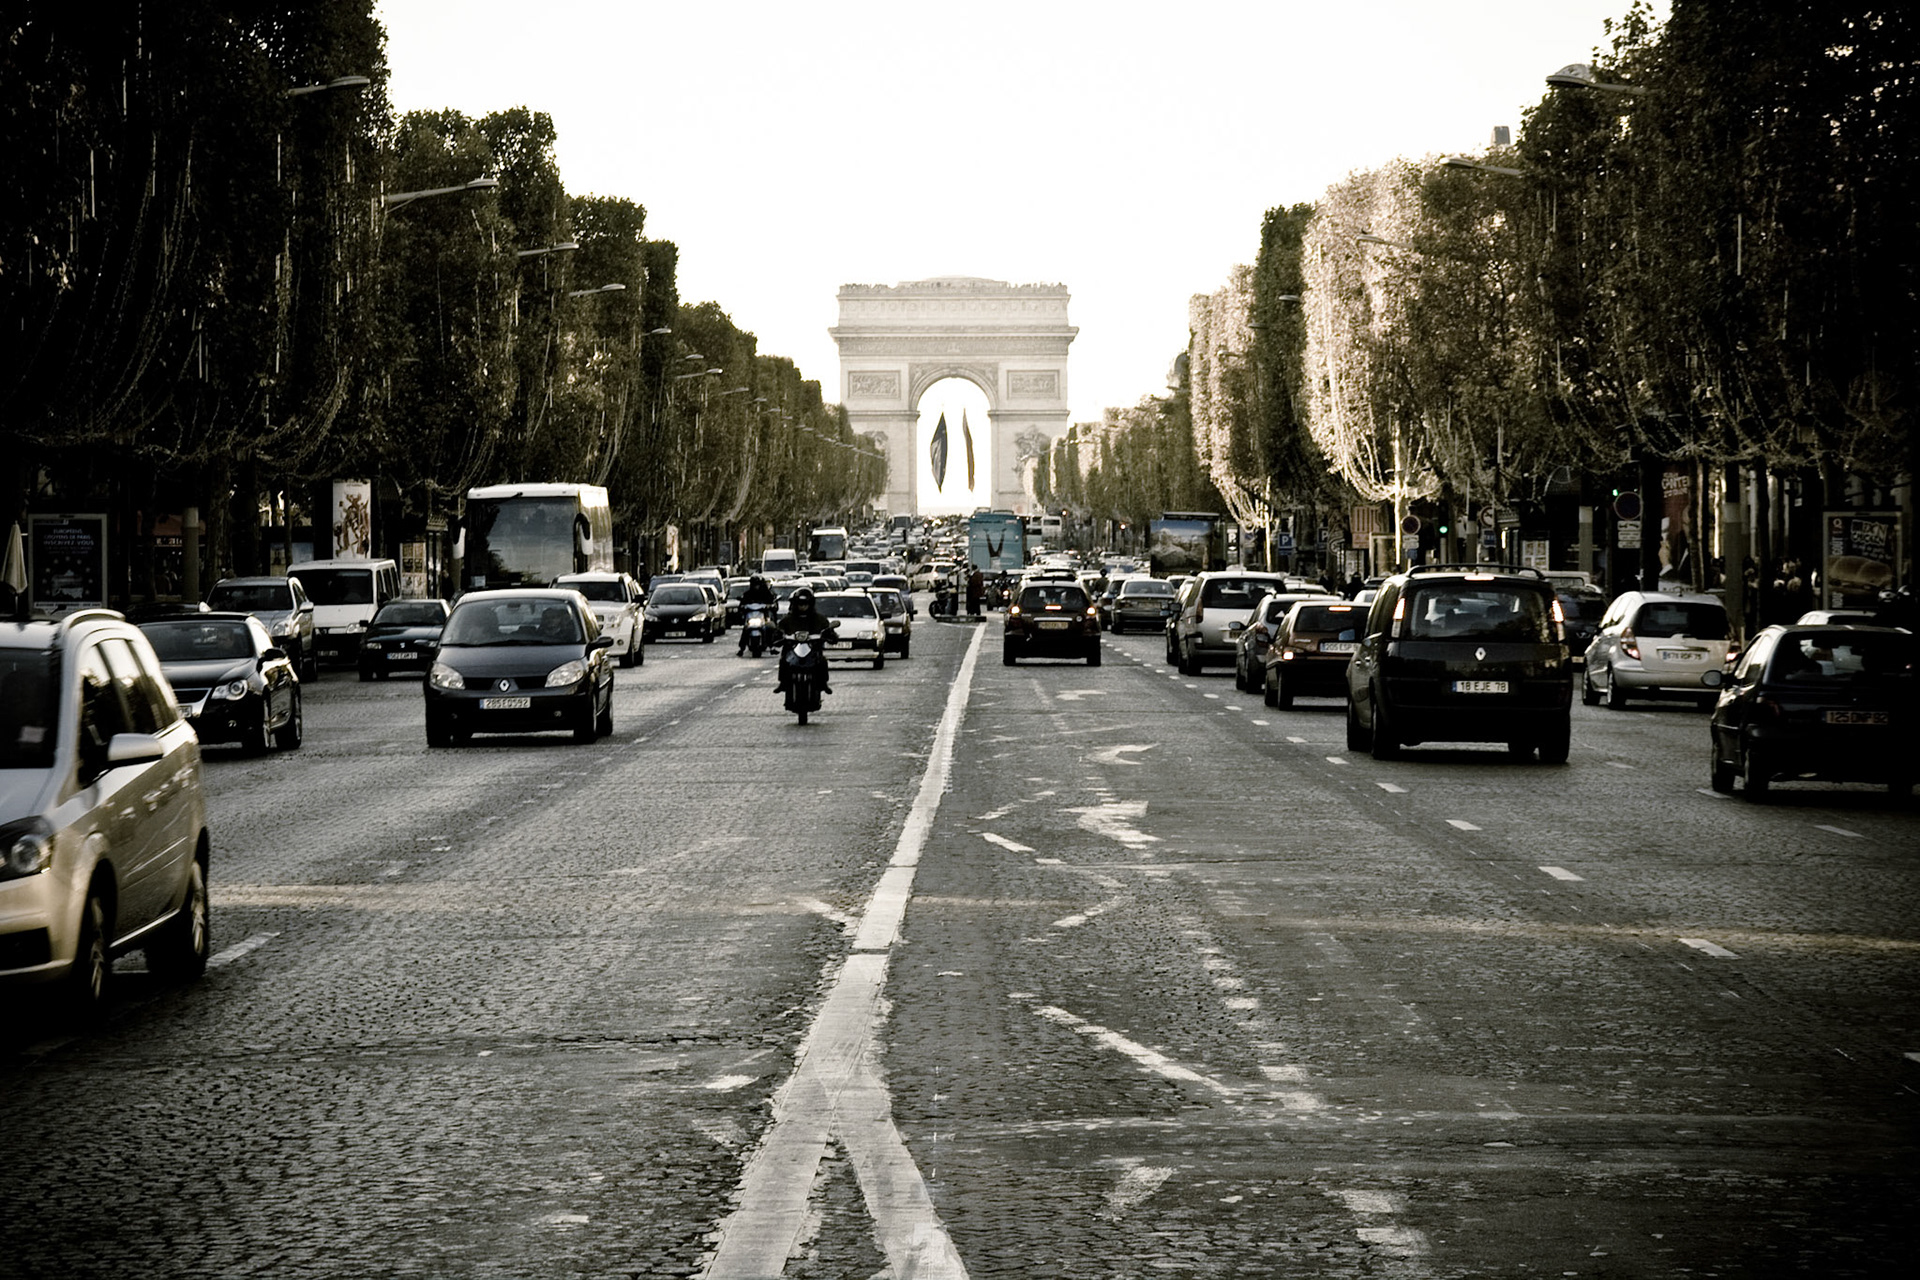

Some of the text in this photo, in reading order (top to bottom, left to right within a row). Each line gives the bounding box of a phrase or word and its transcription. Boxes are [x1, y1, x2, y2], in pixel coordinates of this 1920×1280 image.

[1281, 535, 1289, 545] P
[1461, 681, 1507, 692] 18 EJE 78
[1831, 712, 1849, 722] 125
